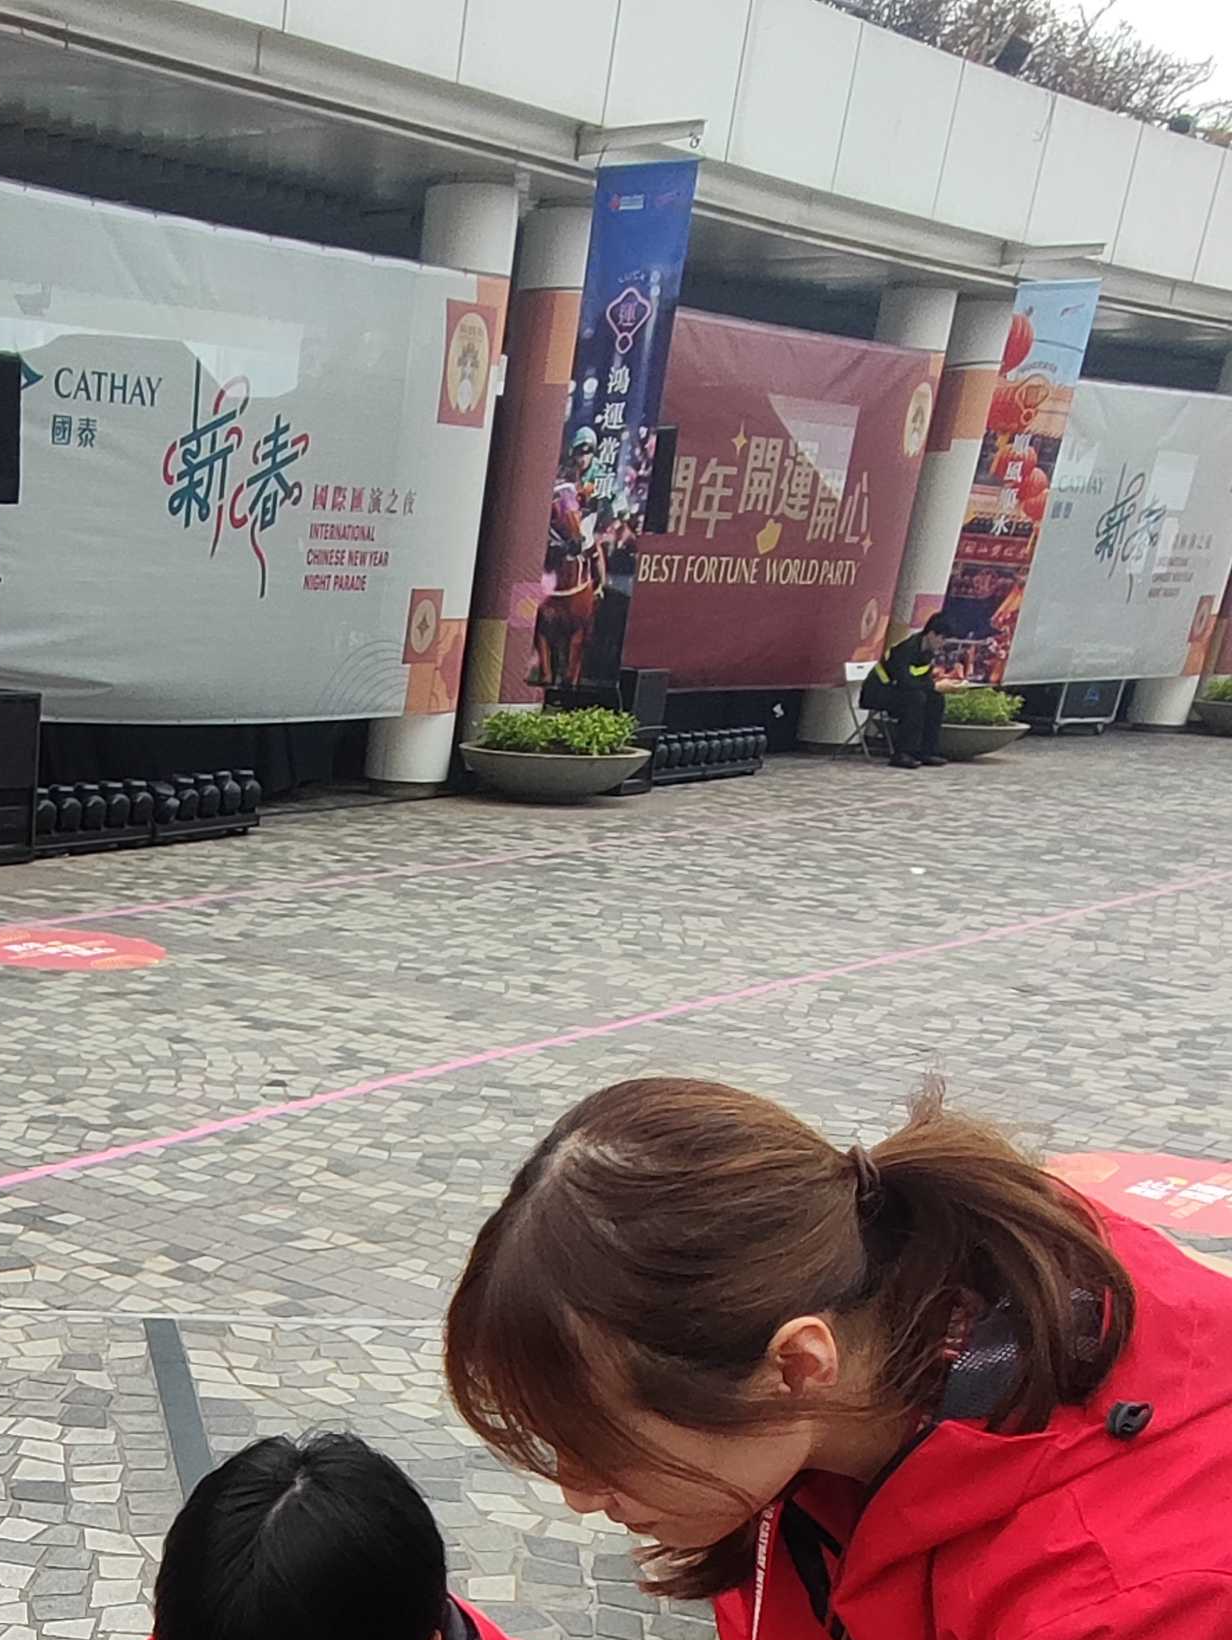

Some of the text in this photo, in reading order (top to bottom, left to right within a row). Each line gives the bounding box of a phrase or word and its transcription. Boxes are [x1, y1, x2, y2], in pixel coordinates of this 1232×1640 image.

[53, 367, 163, 407] CATHAY
[51, 414, 98, 448] 國泰
[162, 357, 310, 600] 新春
[309, 523, 376, 542] INTERNATIONAL
[306, 547, 390, 567] CHINESE NEW YEAR
[637, 554, 863, 585] BEST FORTUNE WORLD PARTY
[303, 574, 367, 592] NIGHT PARADE
